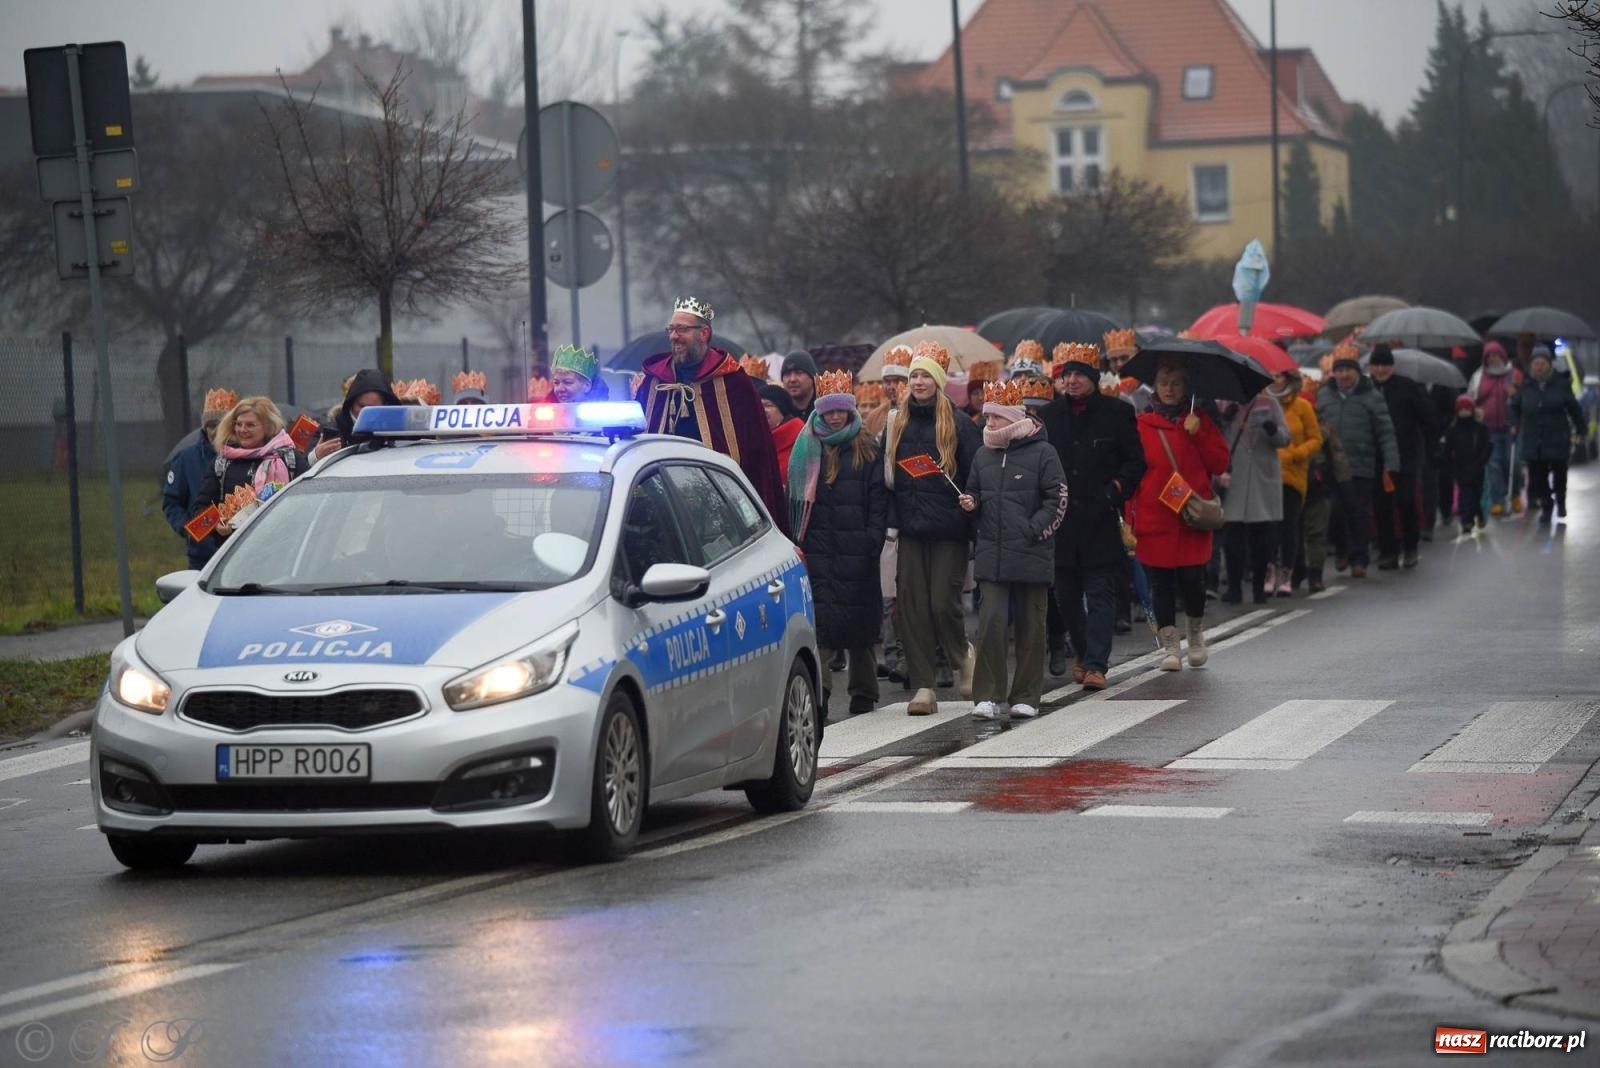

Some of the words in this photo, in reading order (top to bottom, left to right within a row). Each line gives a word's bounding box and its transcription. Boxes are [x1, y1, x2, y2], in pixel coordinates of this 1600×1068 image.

[434, 407, 522, 429] POLICJA
[237, 640, 393, 660] POLICJA
[665, 625, 711, 673] POLICJA
[287, 671, 314, 680] KIA
[235, 748, 284, 775] HPP
[294, 747, 361, 775] R006
